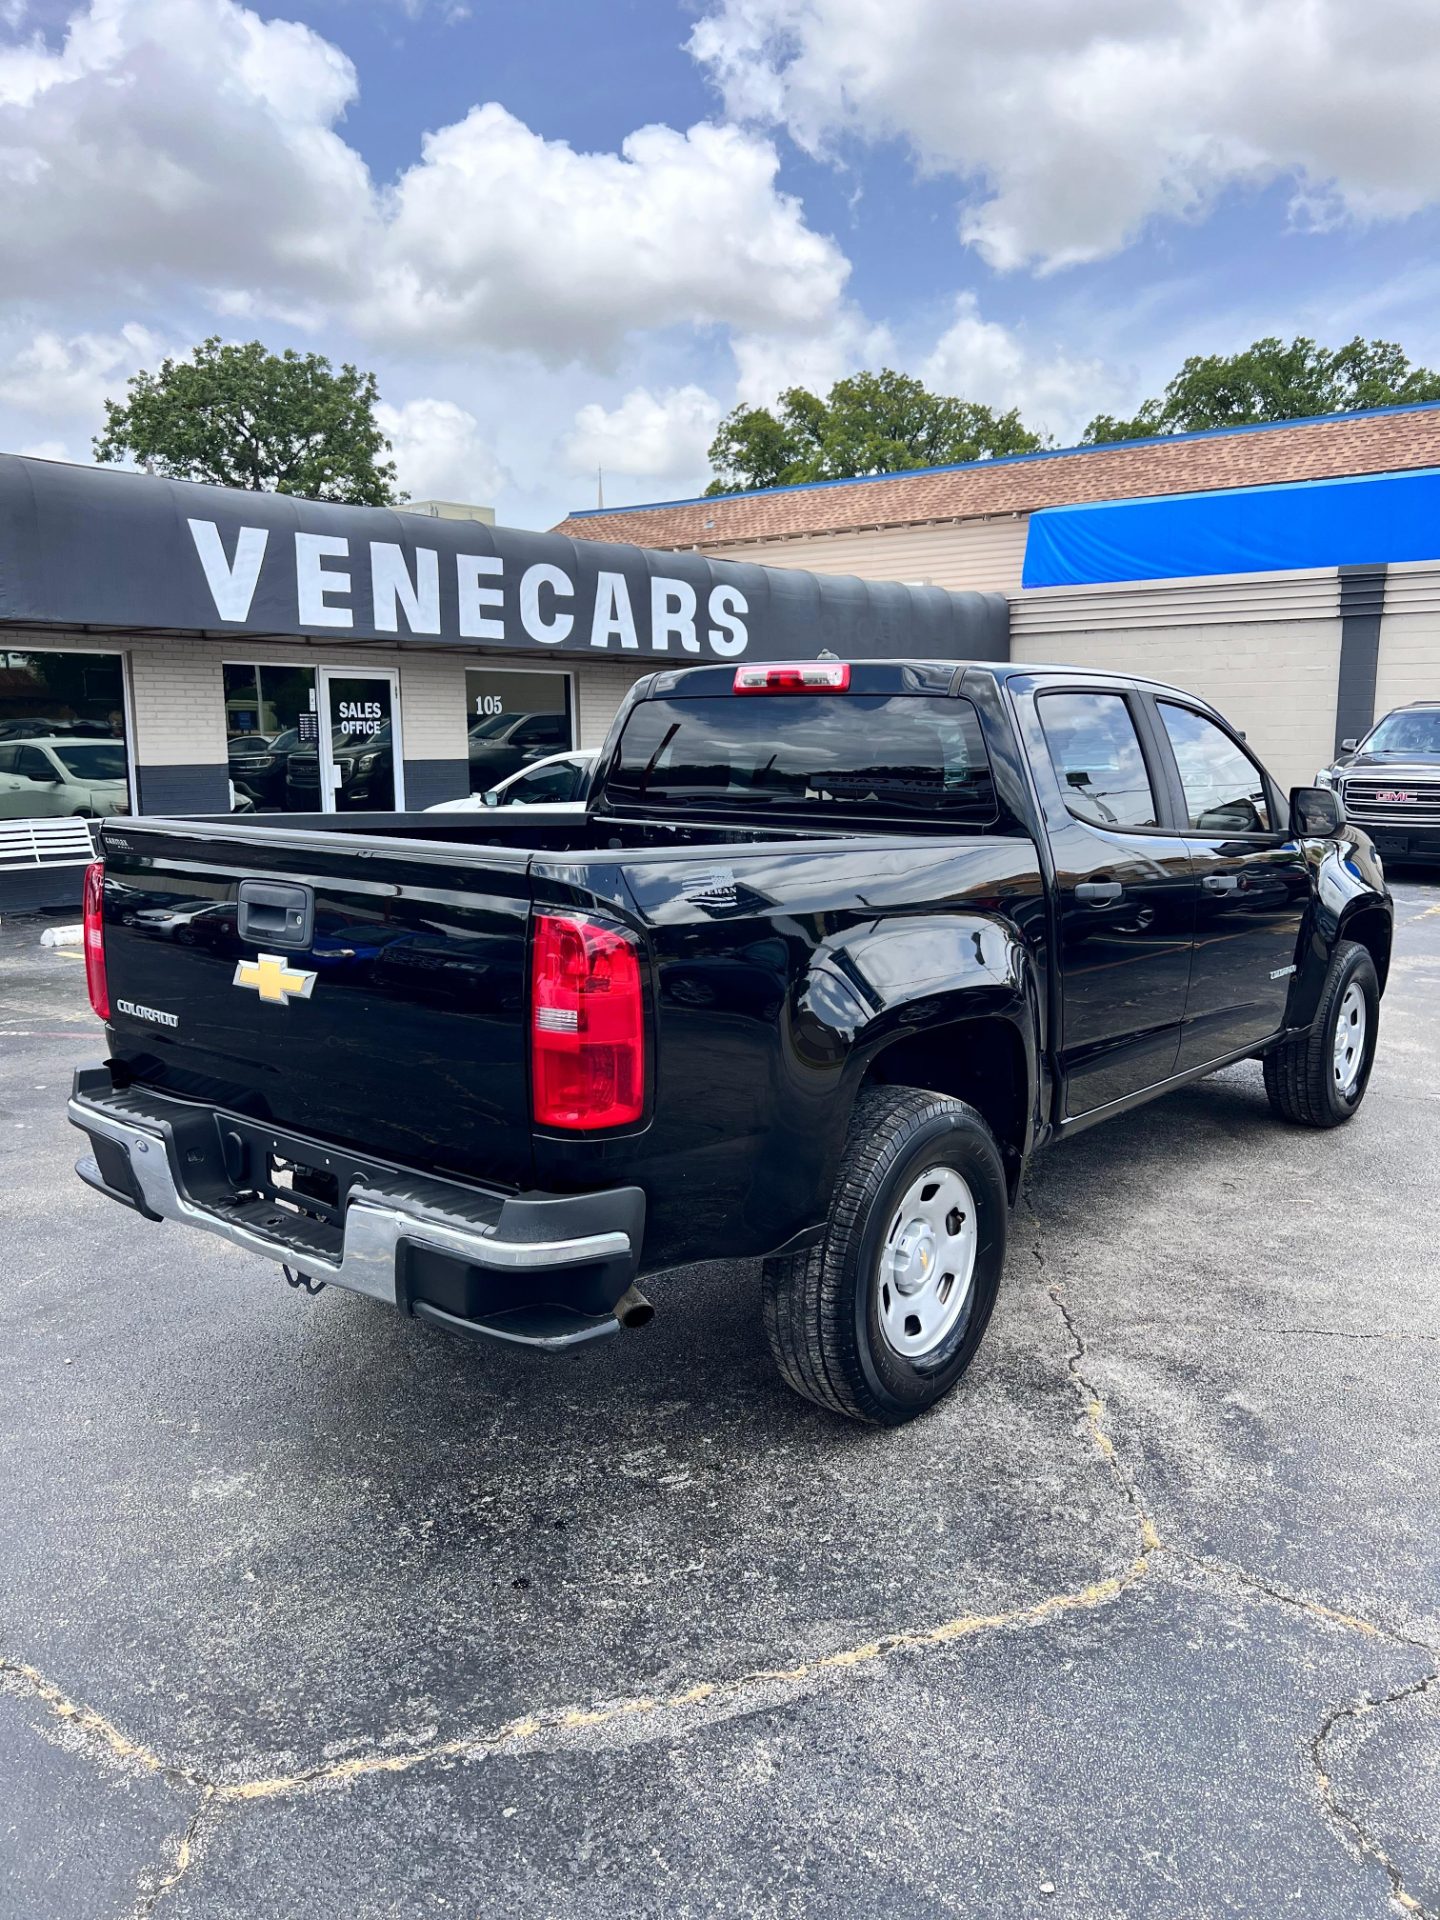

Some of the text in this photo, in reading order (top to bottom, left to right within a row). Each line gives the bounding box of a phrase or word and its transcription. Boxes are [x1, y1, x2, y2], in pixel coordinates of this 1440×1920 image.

[187, 519, 749, 657] VENECARS
[339, 702, 381, 718] SALES
[476, 695, 503, 715] 105
[341, 720, 381, 735] OFFICE
[1376, 791, 1418, 803] GMC
[116, 999, 179, 1028] COLORADO
